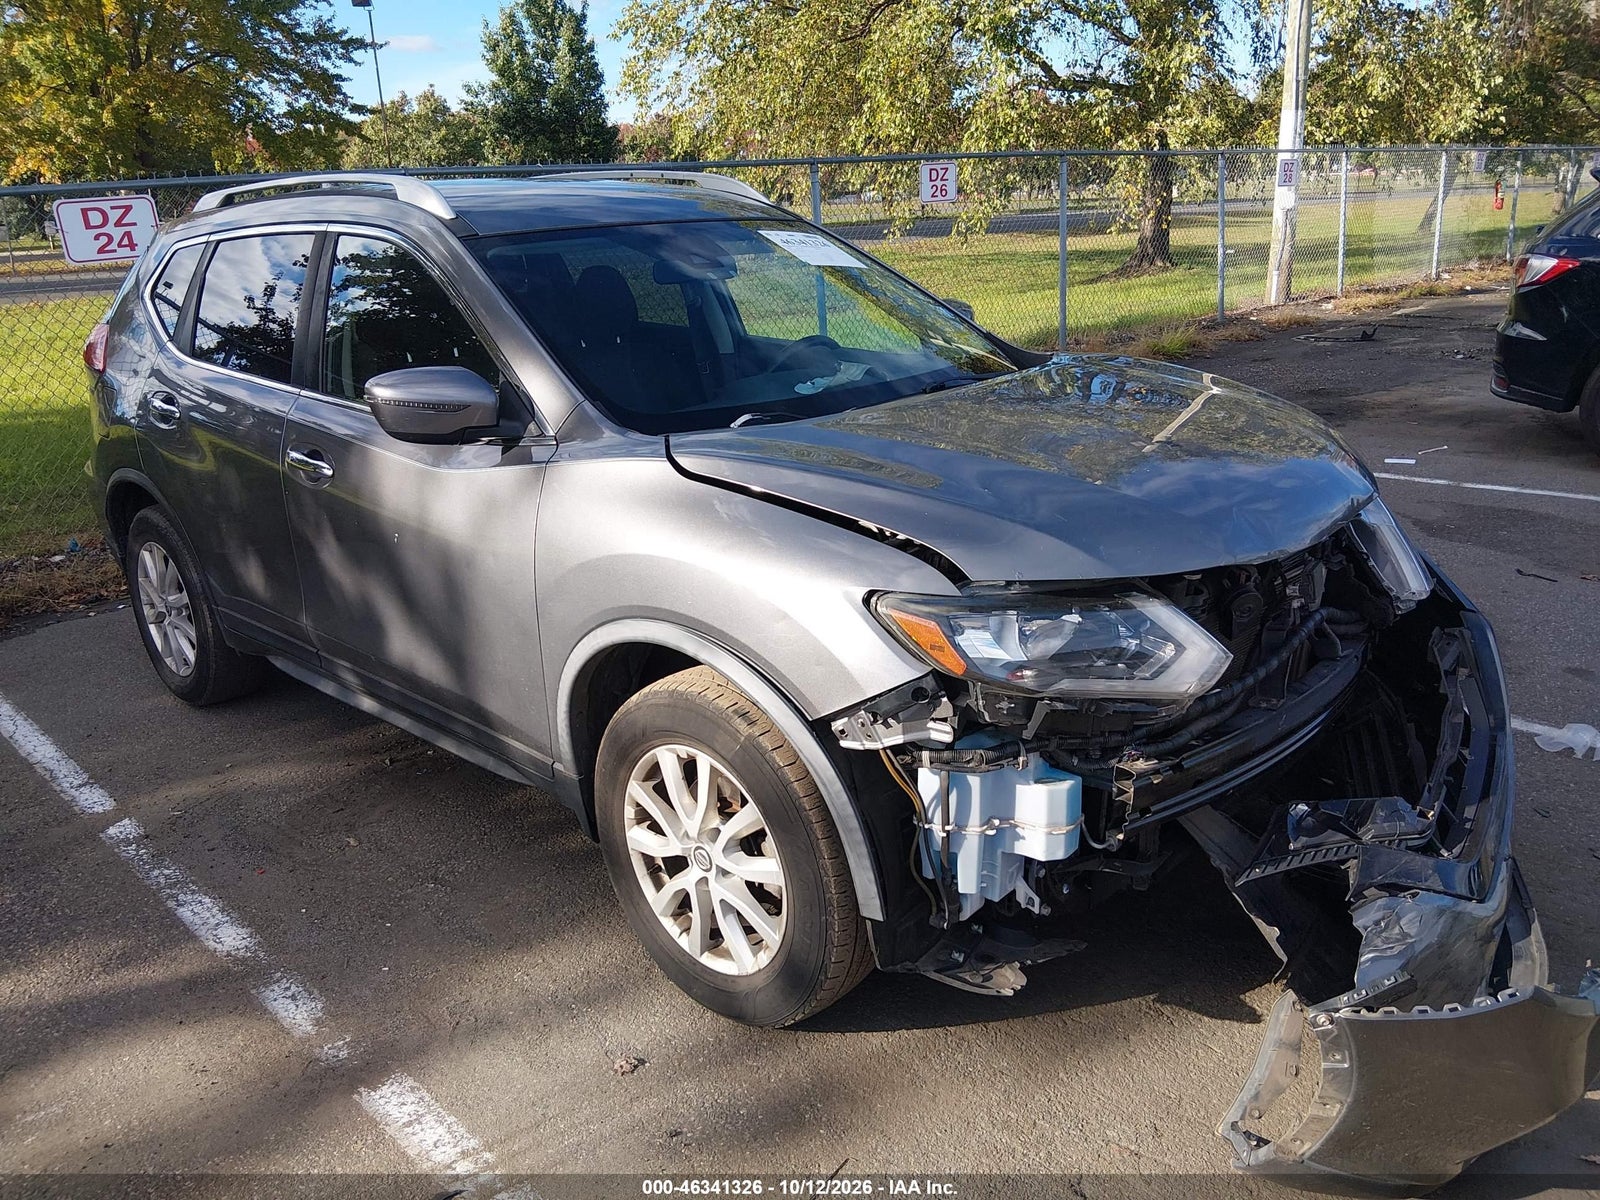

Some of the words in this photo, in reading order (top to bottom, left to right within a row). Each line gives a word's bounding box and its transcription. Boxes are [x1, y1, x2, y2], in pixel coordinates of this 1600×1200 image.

[928, 167, 949, 182] DZ
[1283, 162, 1295, 173] DZ
[1283, 173, 1293, 184] 28
[930, 183, 948, 198] 26
[80, 204, 138, 231] DZ
[93, 230, 138, 255] 24
